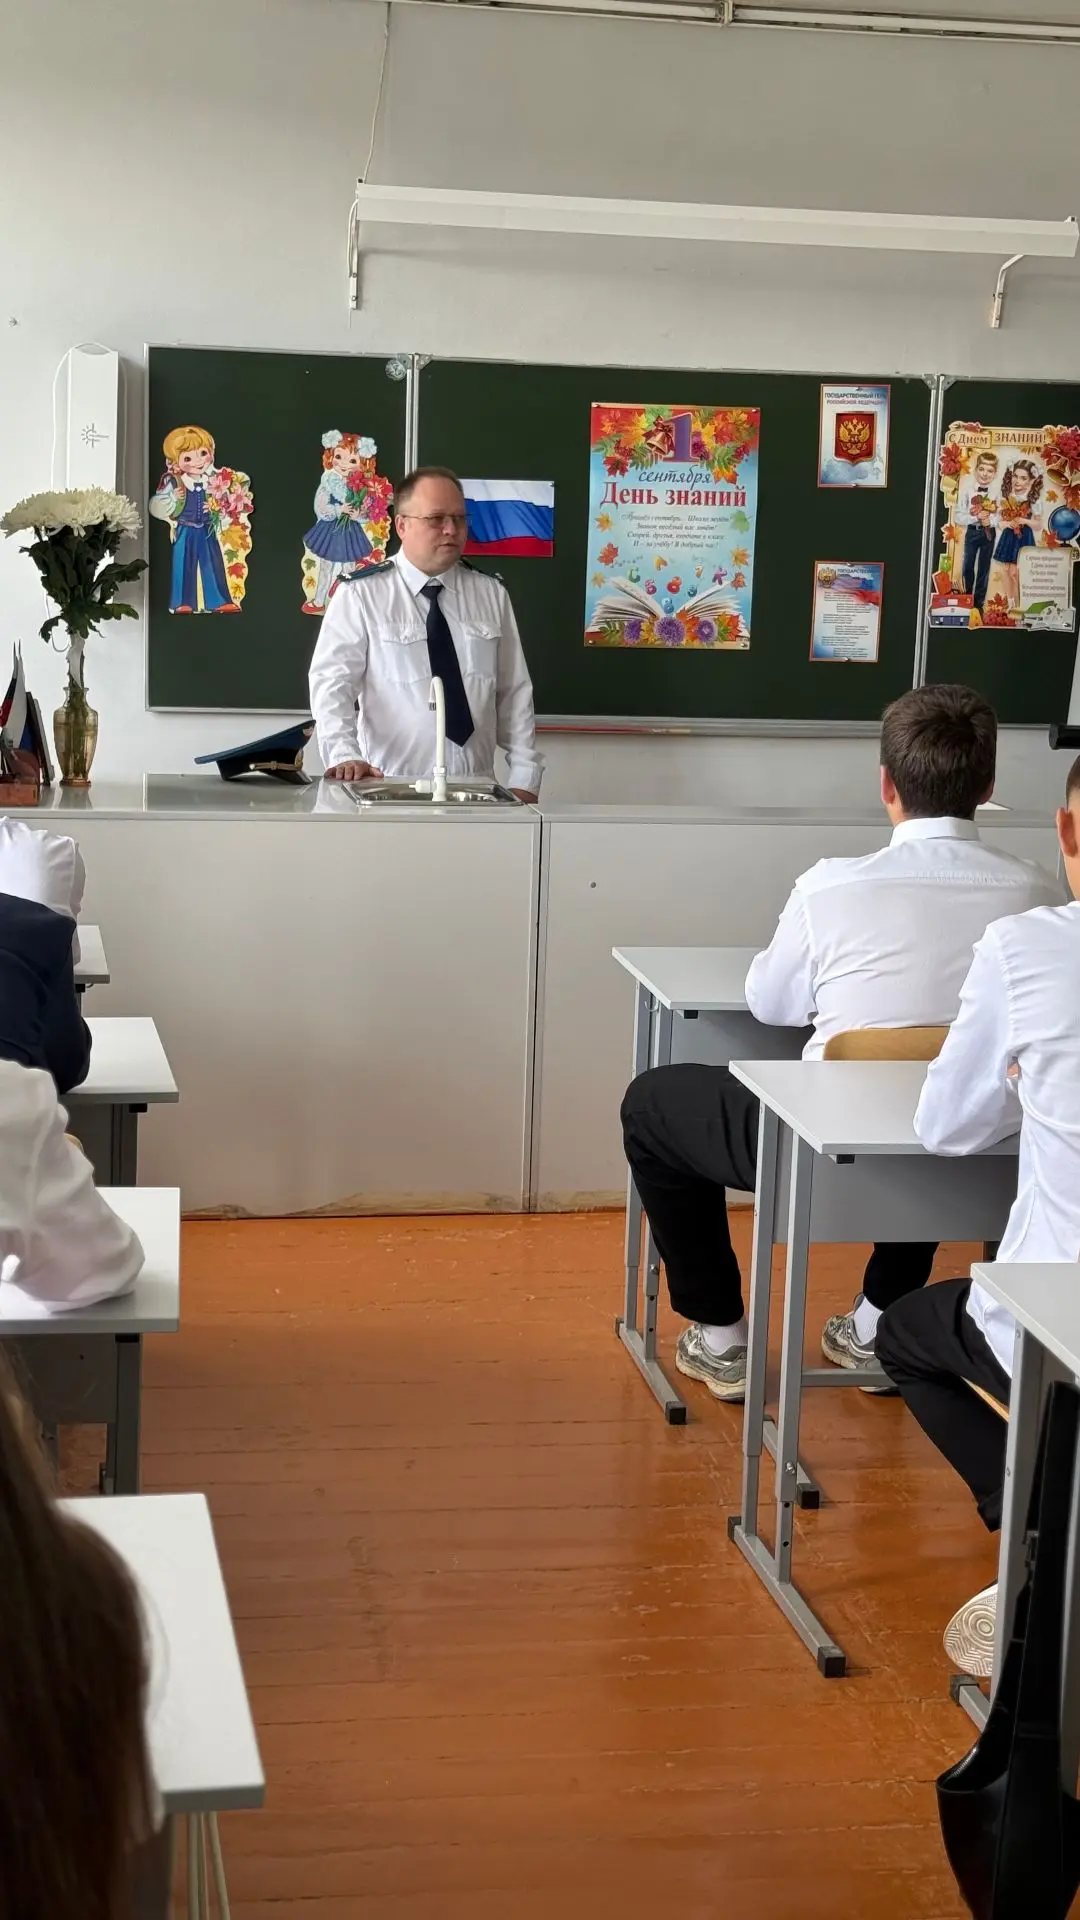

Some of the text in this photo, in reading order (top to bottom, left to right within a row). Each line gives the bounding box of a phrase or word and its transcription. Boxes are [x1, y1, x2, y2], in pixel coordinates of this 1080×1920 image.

[949, 433, 956, 443] С
[994, 431, 1046, 443] ЗНАНИЙ!
[638, 464, 711, 491] сентября
[600, 481, 746, 510] День знаний
